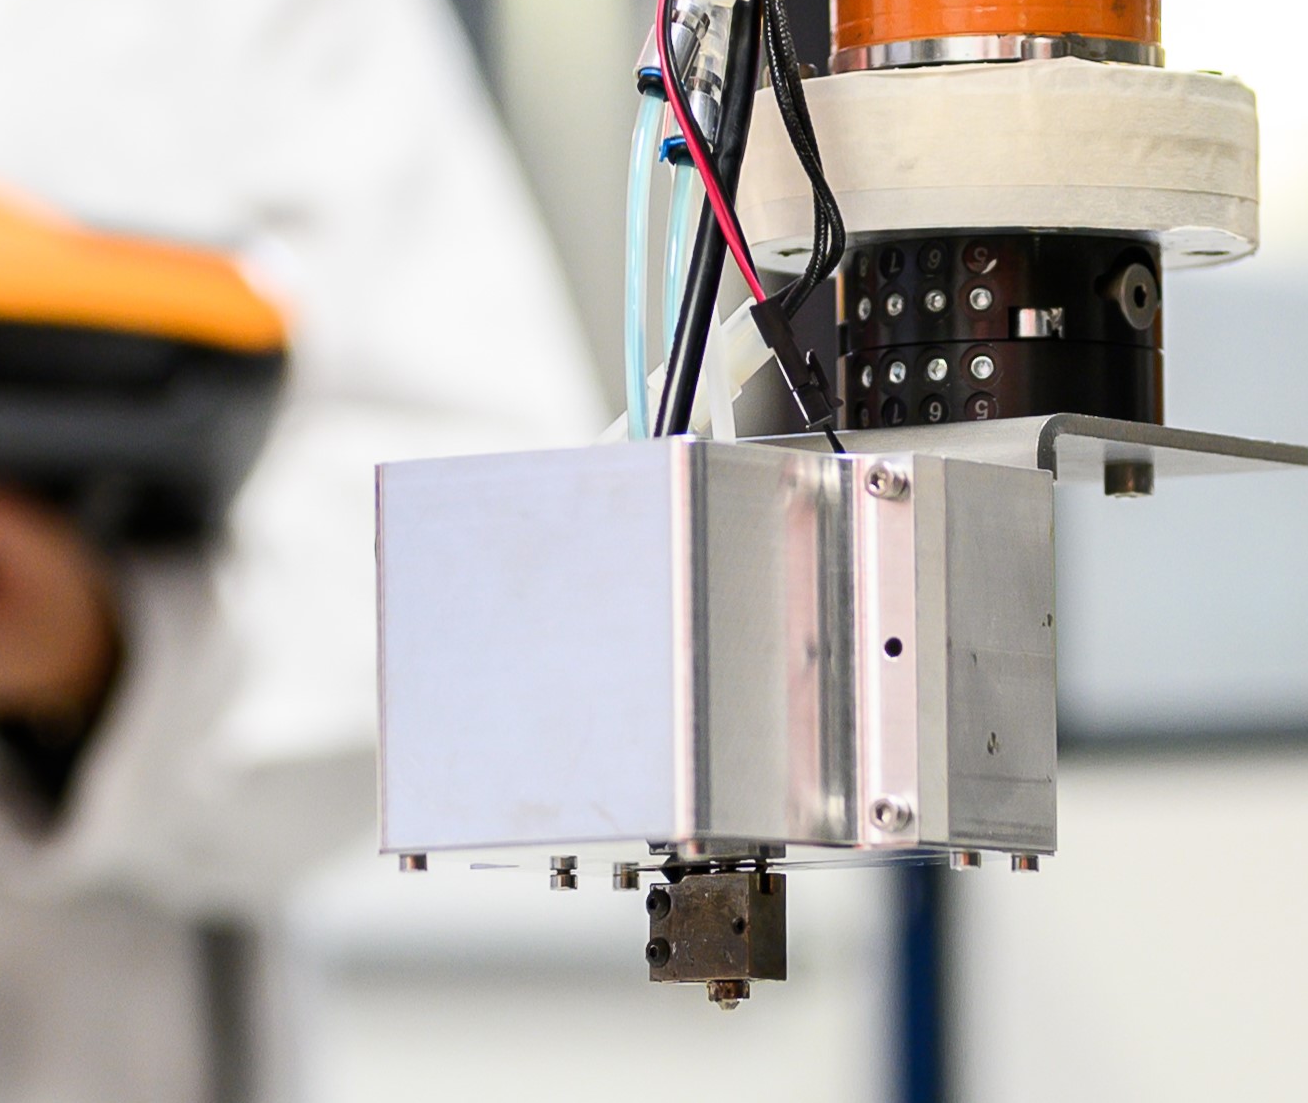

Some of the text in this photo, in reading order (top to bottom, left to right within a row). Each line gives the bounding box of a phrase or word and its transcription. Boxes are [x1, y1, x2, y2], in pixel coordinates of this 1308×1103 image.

[927, 248, 942, 270] 6
[928, 401, 943, 423] 6
[974, 399, 989, 420] 5
